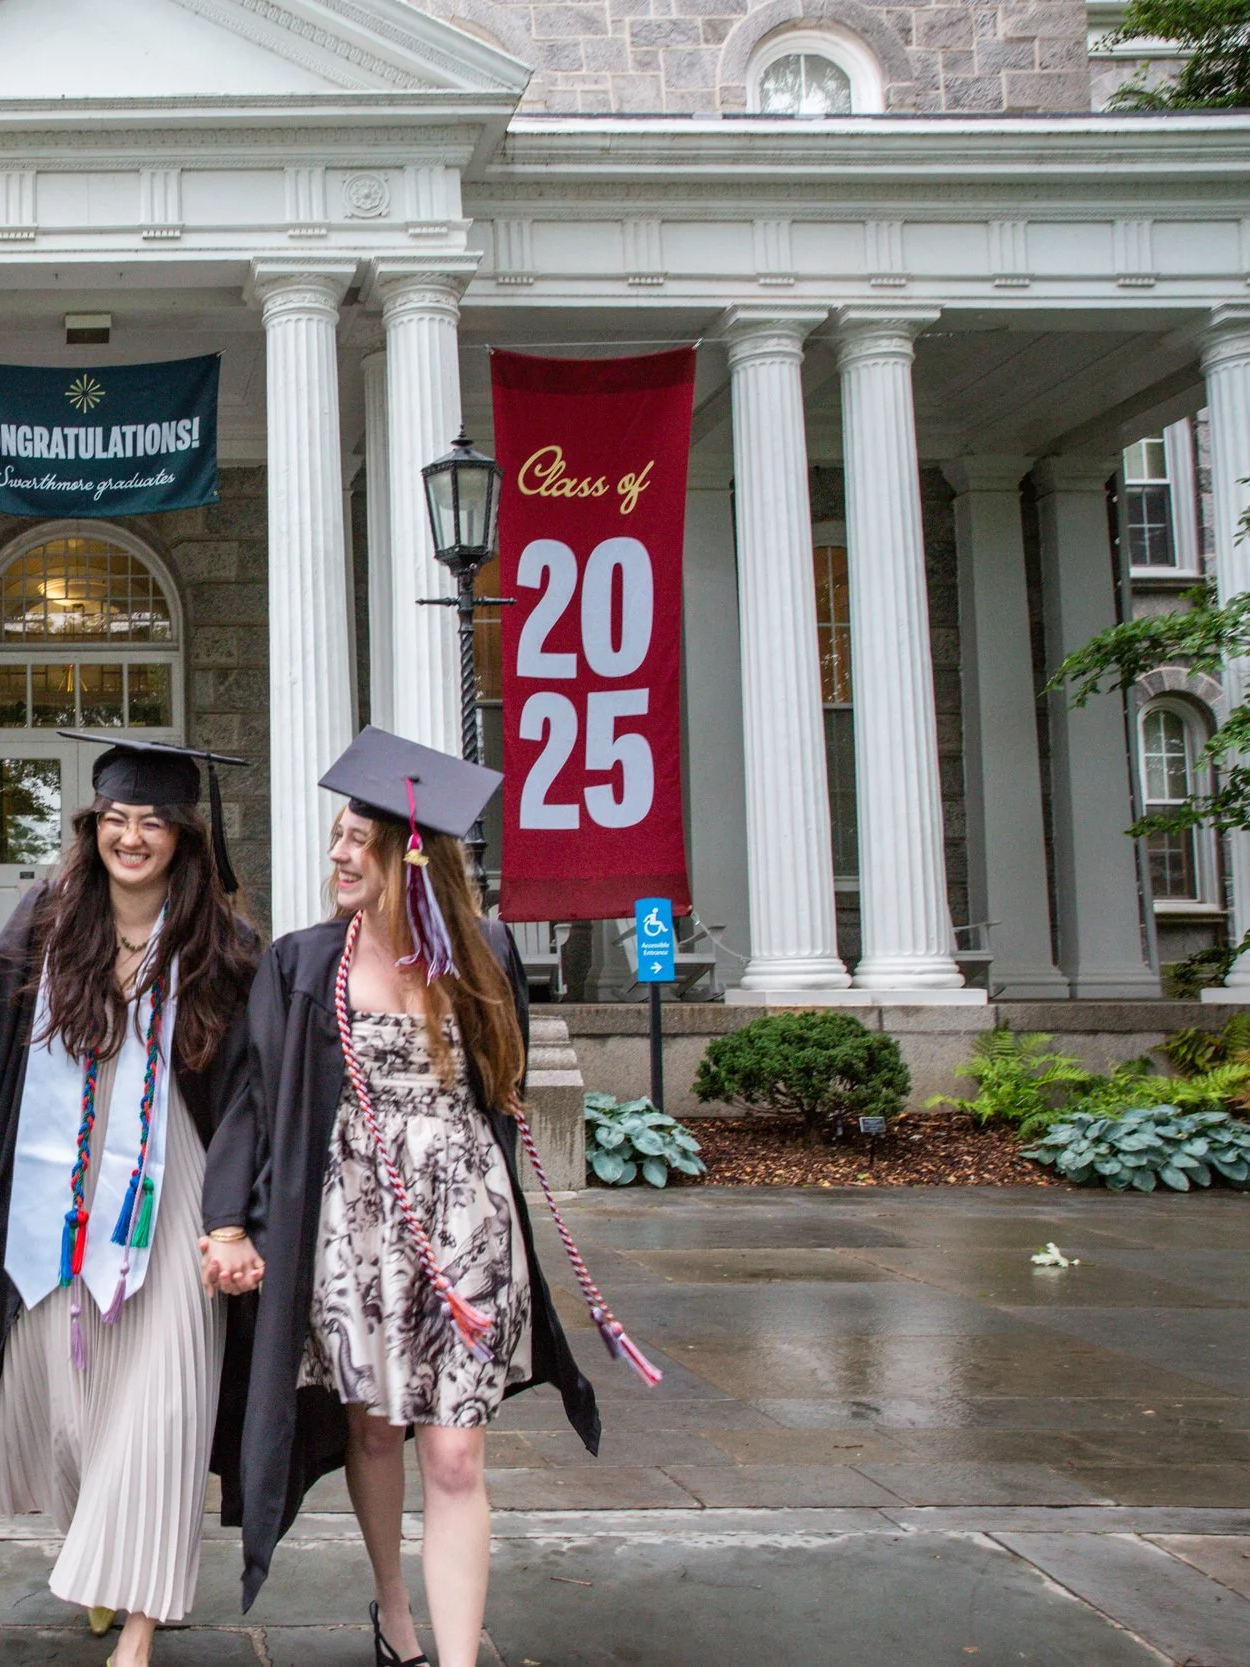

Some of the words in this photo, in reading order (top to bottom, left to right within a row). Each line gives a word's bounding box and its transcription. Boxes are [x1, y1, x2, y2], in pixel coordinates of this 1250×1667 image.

[94, 468, 176, 501] graduates
[517, 445, 609, 498] Class
[617, 460, 655, 515] of
[516, 537, 653, 679] 20
[519, 688, 655, 829] 25
